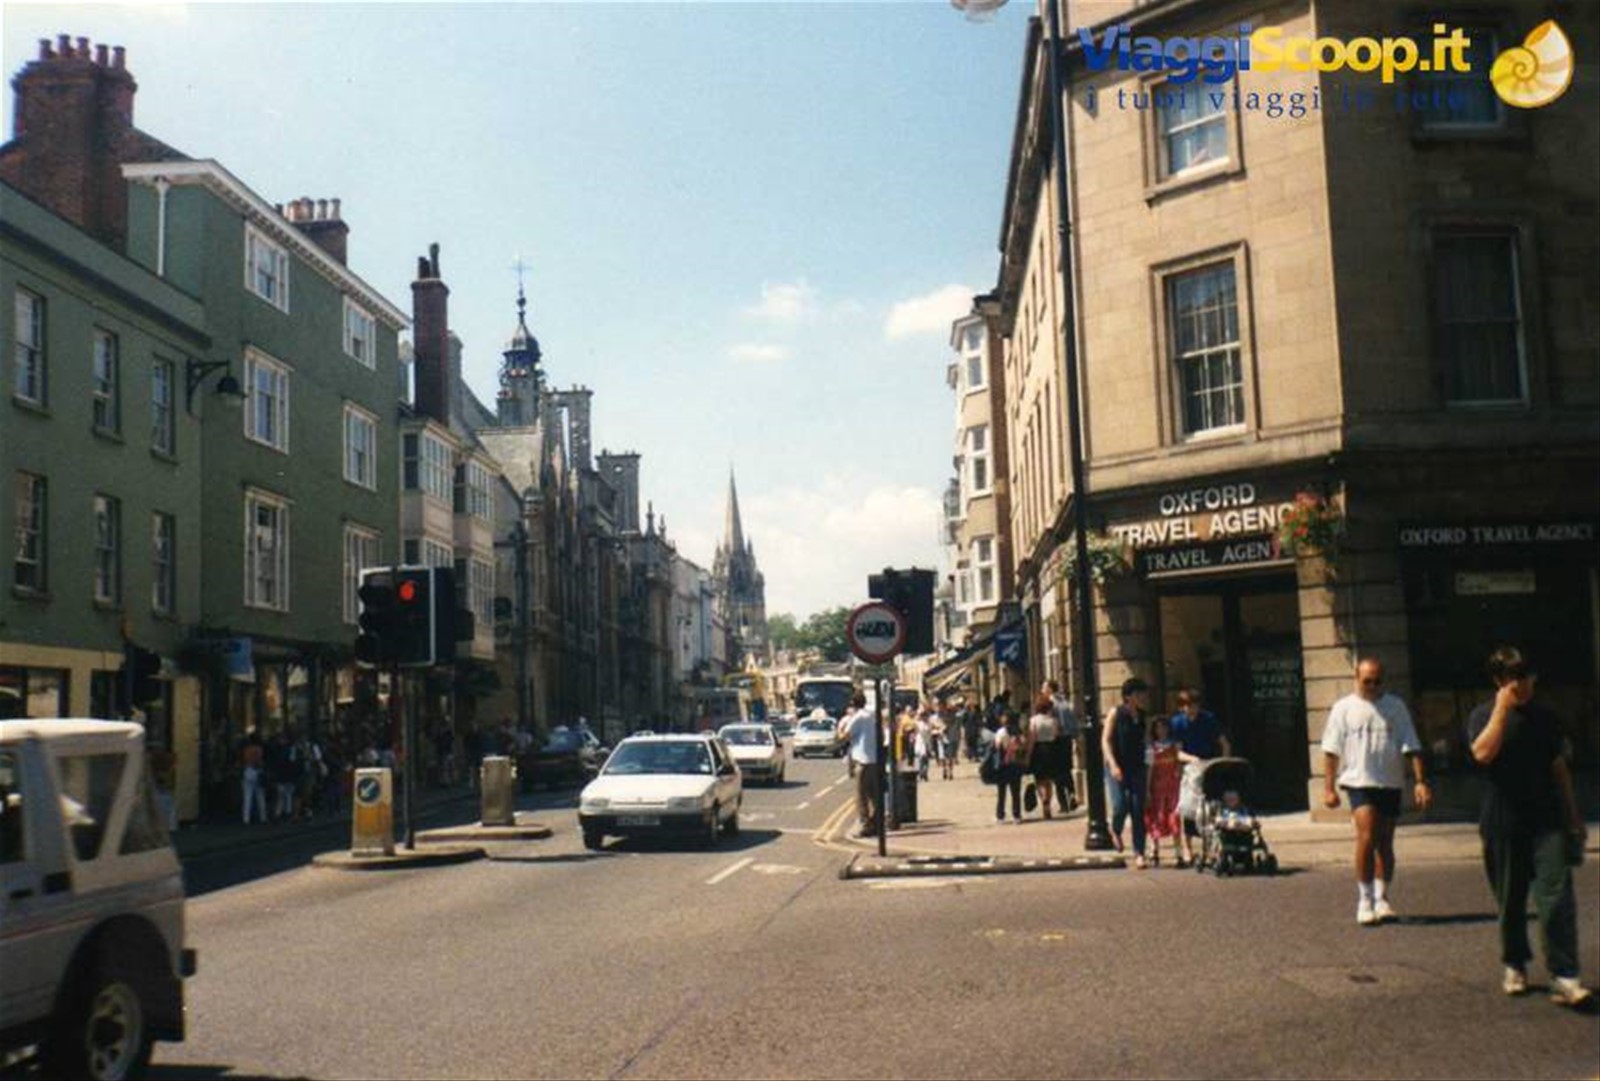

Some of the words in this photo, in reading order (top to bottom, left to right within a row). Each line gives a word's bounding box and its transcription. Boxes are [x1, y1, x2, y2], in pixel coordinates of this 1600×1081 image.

[1159, 483, 1256, 516] OXFORD
[1111, 515, 1198, 545] TRAVEL
[1208, 502, 1296, 535] AGENC
[1400, 528, 1466, 545] OXFORD
[1471, 526, 1533, 543] TRAVEL
[1147, 548, 1210, 571] TRAVEL
[1221, 540, 1272, 563] AGEN
